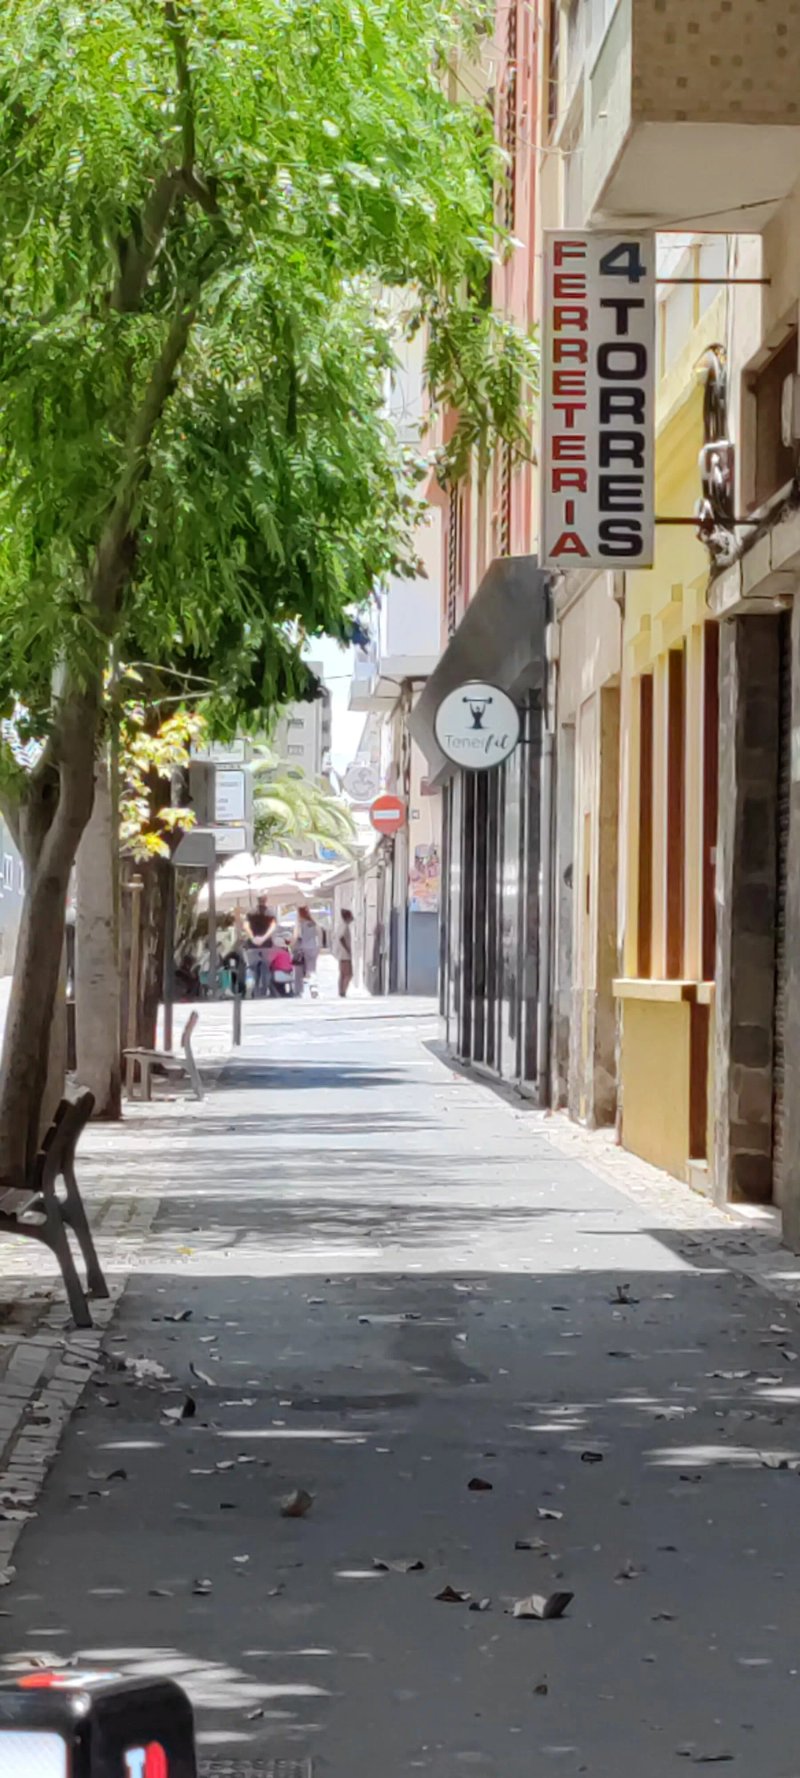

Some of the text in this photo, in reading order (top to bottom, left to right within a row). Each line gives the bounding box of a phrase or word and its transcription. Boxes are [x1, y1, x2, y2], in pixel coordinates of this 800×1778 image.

[549, 240, 591, 558] FERRETERIA
[597, 242, 648, 557] 4 TORRES
